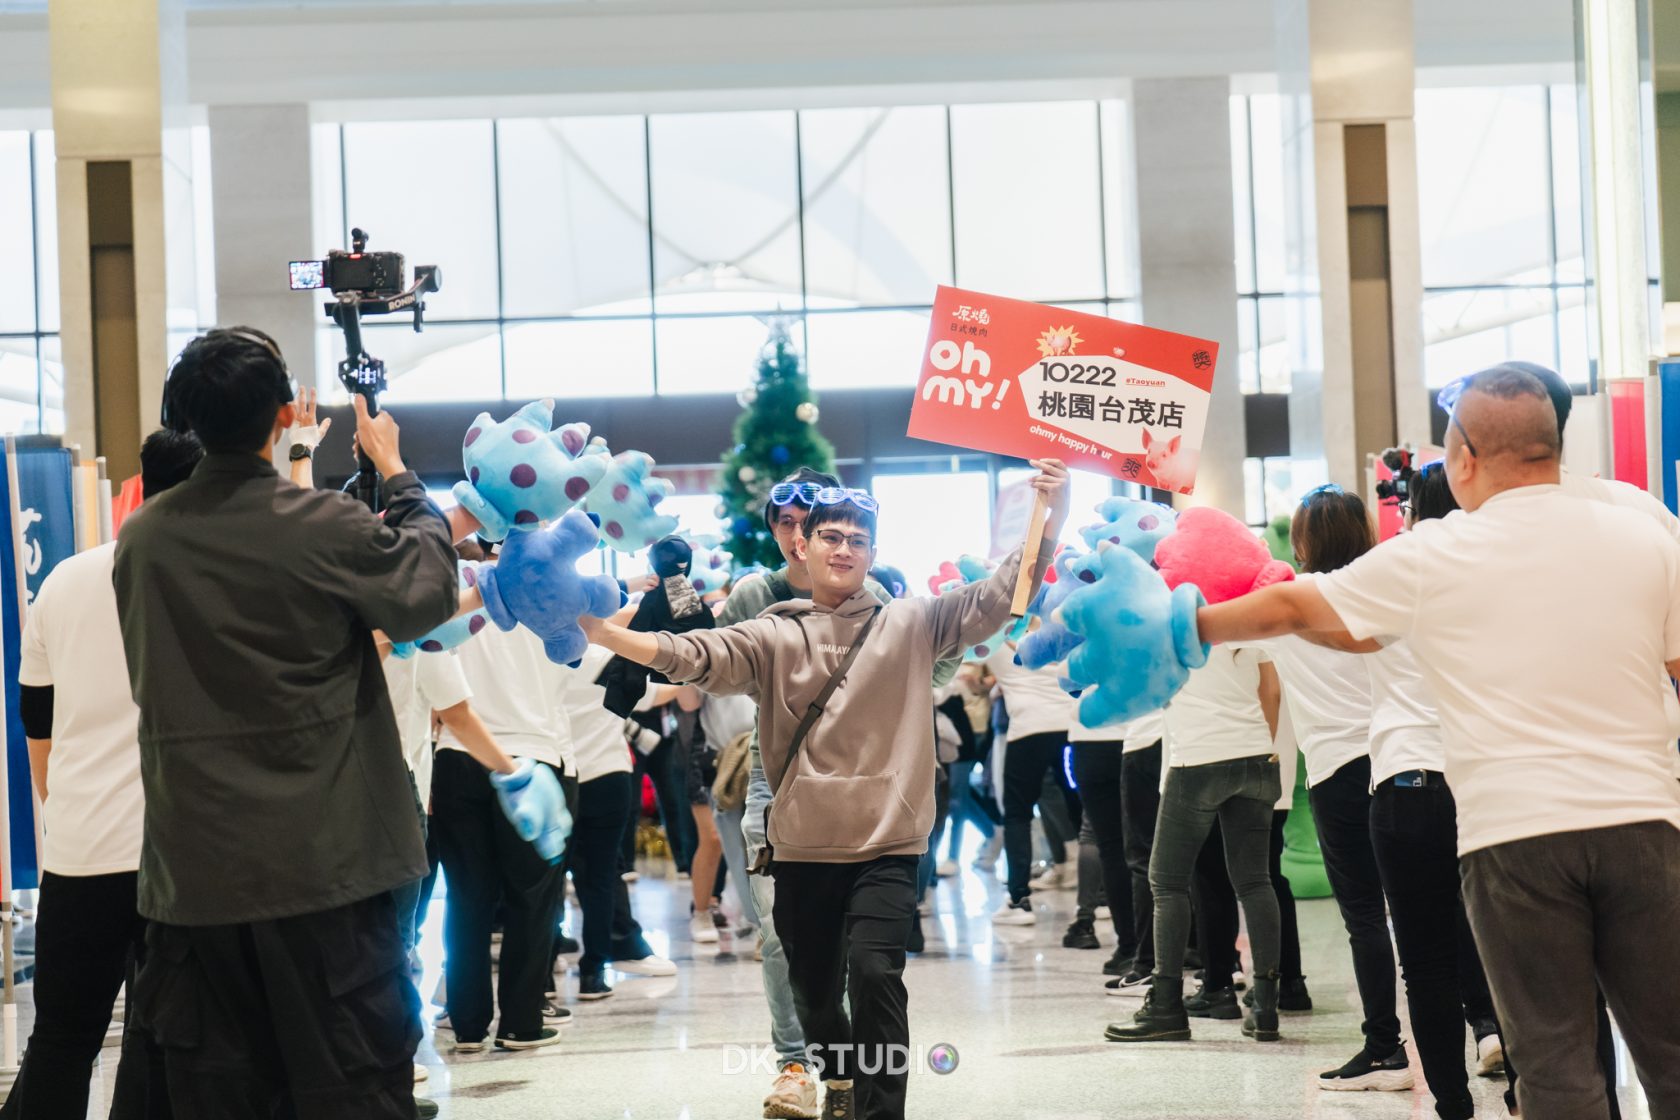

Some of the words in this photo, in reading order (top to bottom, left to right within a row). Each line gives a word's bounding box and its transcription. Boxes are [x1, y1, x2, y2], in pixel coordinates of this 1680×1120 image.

[388, 294, 415, 310] RONIN
[1039, 361, 1116, 387] 10222
[1037, 390, 1186, 429] 桃園台茂店
[1029, 425, 1057, 442] ohmy
[1058, 433, 1090, 453] happy
